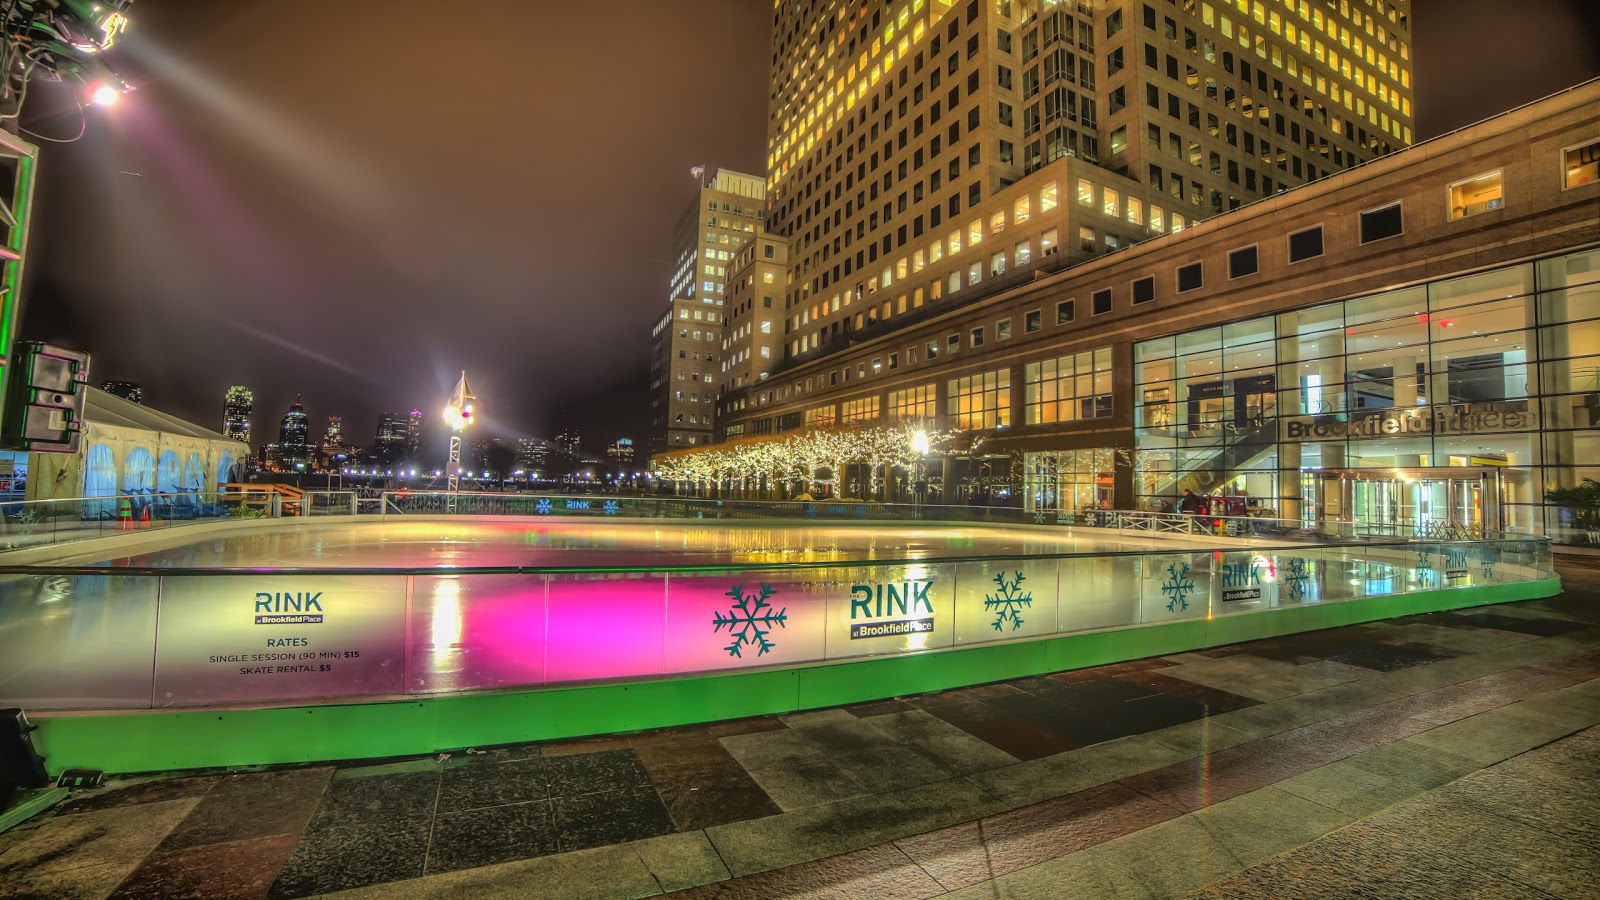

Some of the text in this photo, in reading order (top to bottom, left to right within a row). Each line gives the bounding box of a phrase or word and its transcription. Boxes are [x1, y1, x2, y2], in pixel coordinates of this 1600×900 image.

[1287, 411, 1428, 439] Brookfield
[566, 501, 590, 509] RINK
[1446, 551, 1468, 569] RINK
[1222, 563, 1260, 588] RINK
[255, 592, 323, 612] RINK
[851, 581, 934, 619] RINK
[262, 616, 303, 624] Brookfield
[860, 622, 909, 637] Brookfield
[267, 638, 308, 647] RATES
[210, 650, 360, 663] SINGLE SESSION (90 MIN) $15
[240, 664, 332, 675] SKATE RENTAL $5
